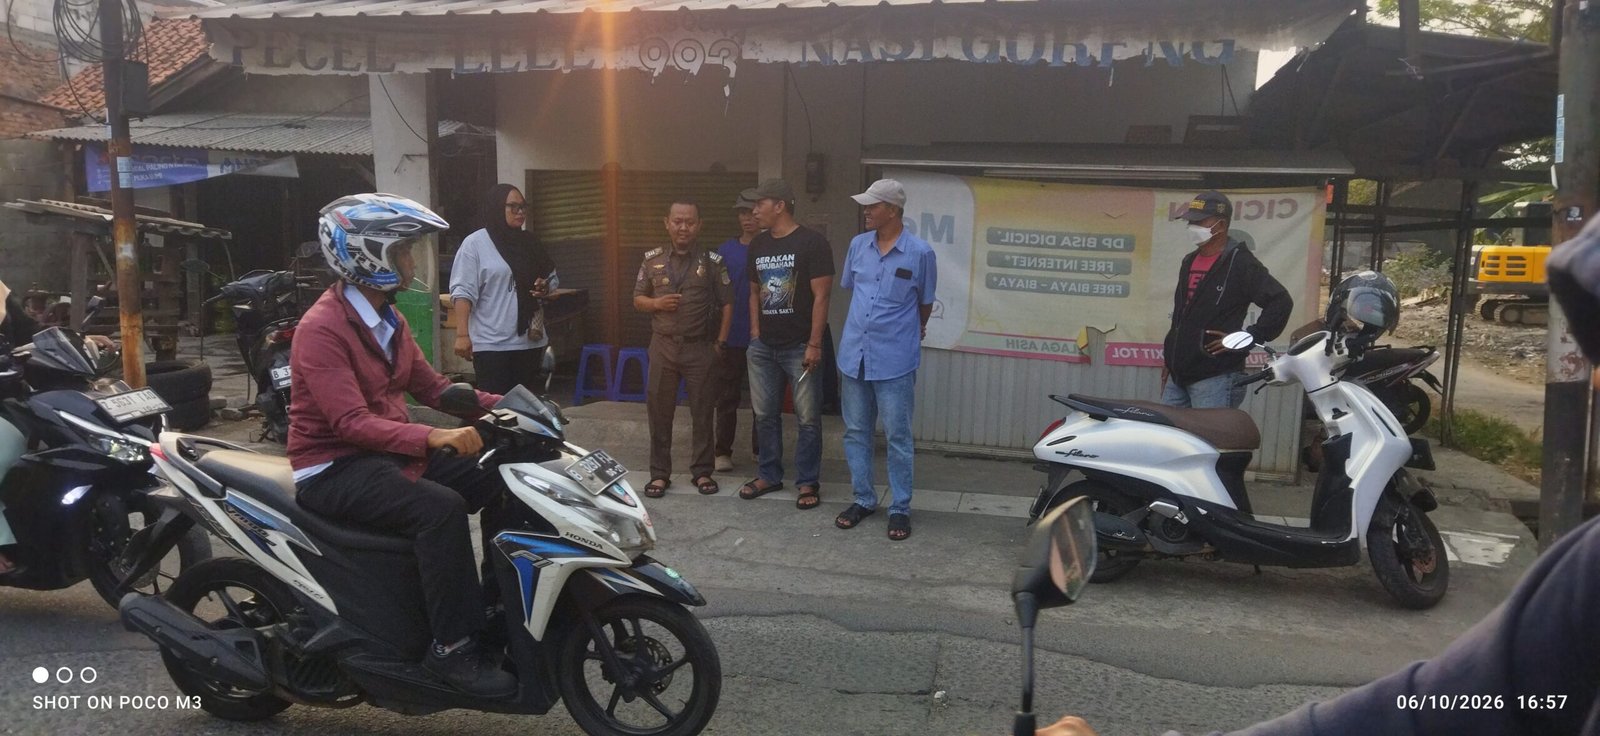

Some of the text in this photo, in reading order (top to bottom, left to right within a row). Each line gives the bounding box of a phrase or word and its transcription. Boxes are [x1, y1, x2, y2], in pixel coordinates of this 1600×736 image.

[228, 29, 397, 73] PECEL
[638, 37, 737, 80] 993
[755, 254, 795, 265] GERAKAN
[273, 370, 279, 379] B
[569, 469, 583, 481] B
[565, 531, 603, 550] HONDA
